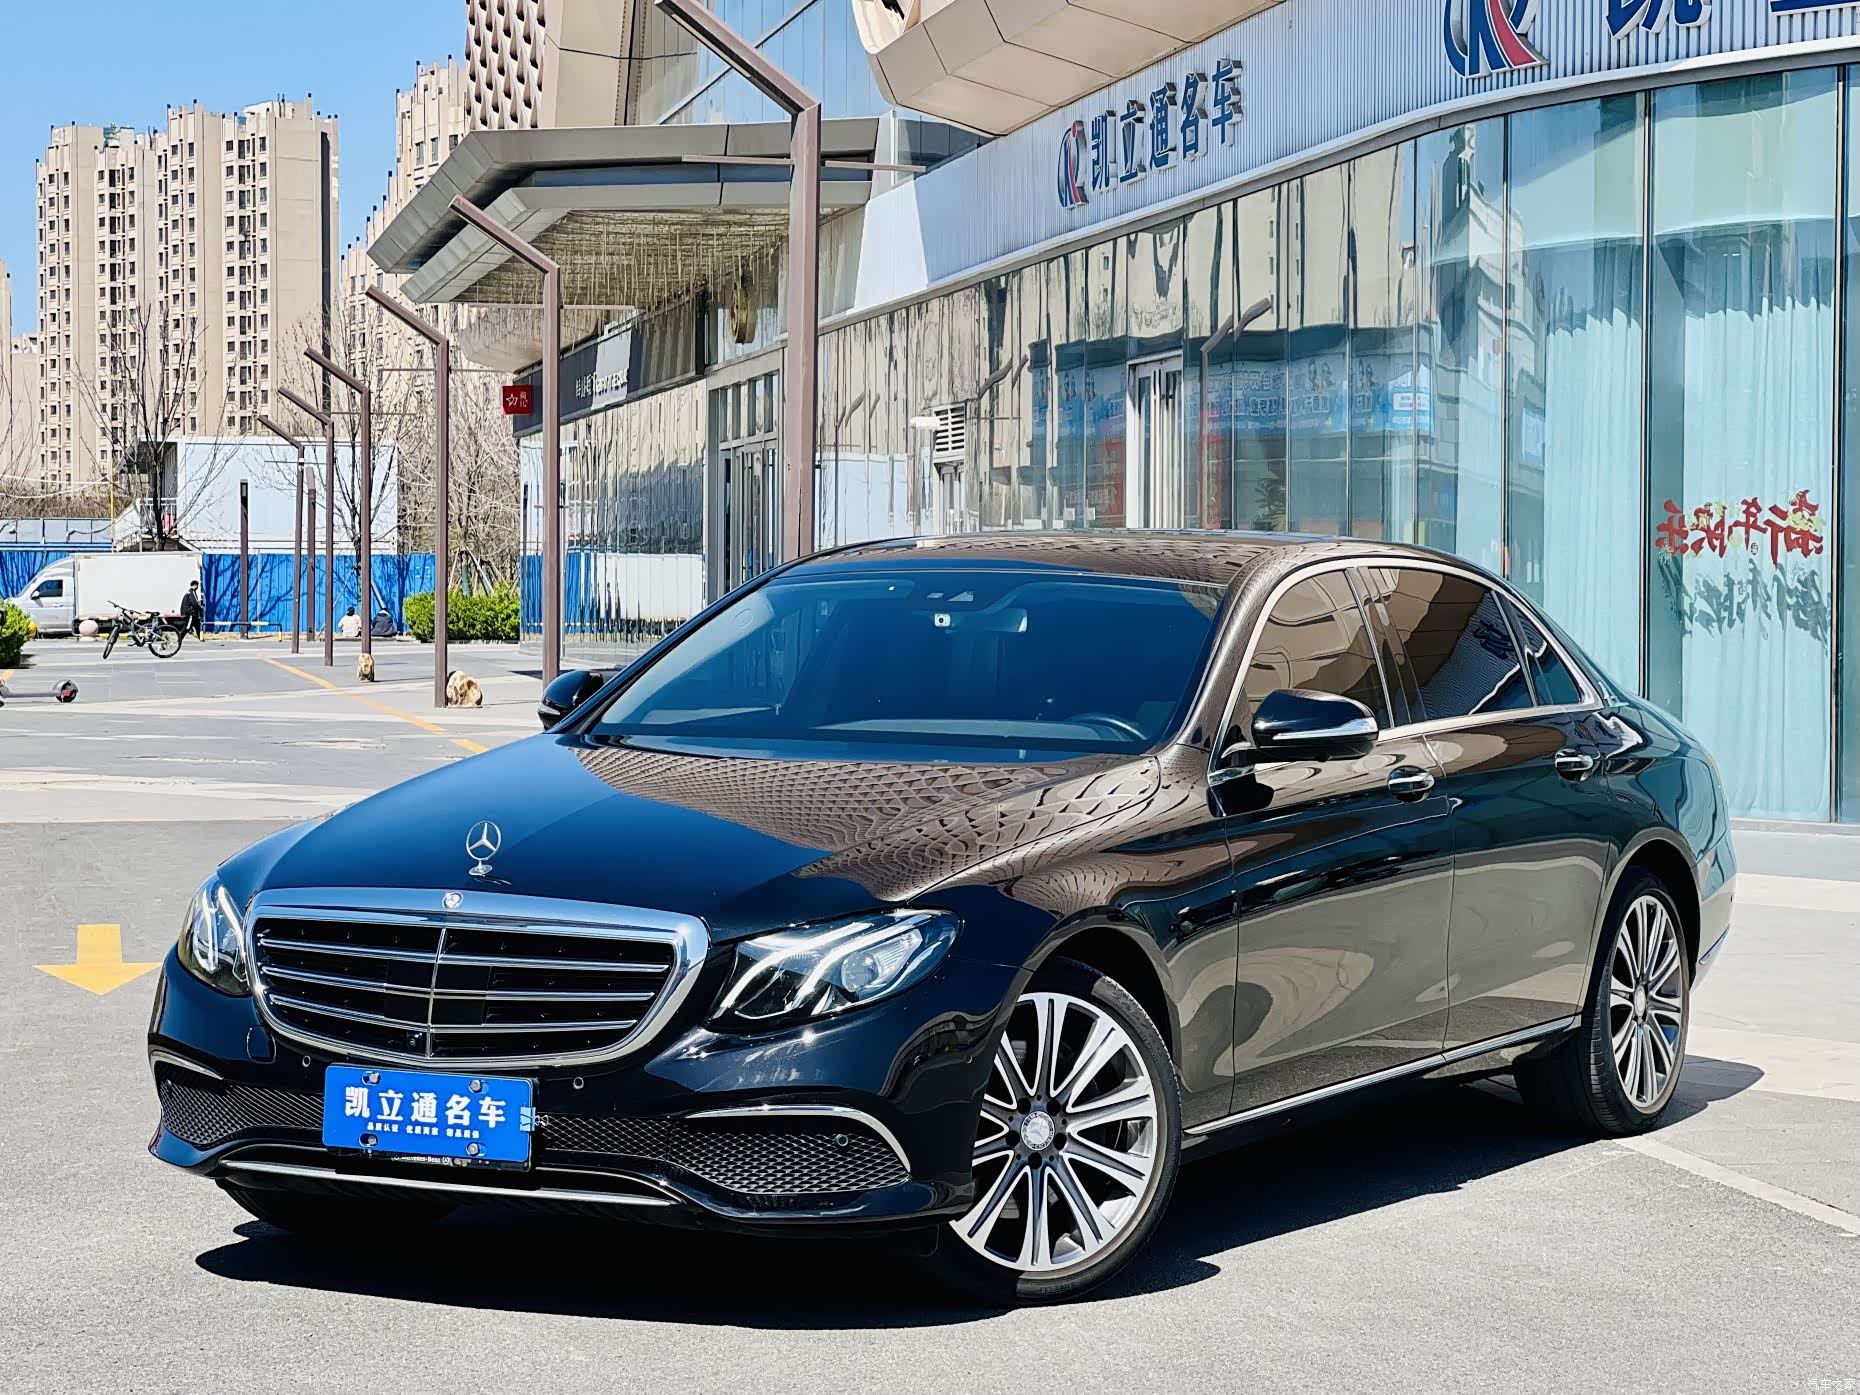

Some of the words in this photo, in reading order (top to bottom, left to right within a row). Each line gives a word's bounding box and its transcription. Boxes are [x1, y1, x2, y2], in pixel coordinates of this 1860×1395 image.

[1090, 59, 1241, 193] 凯立通名车
[344, 1086, 506, 1129] 凯立通名车
